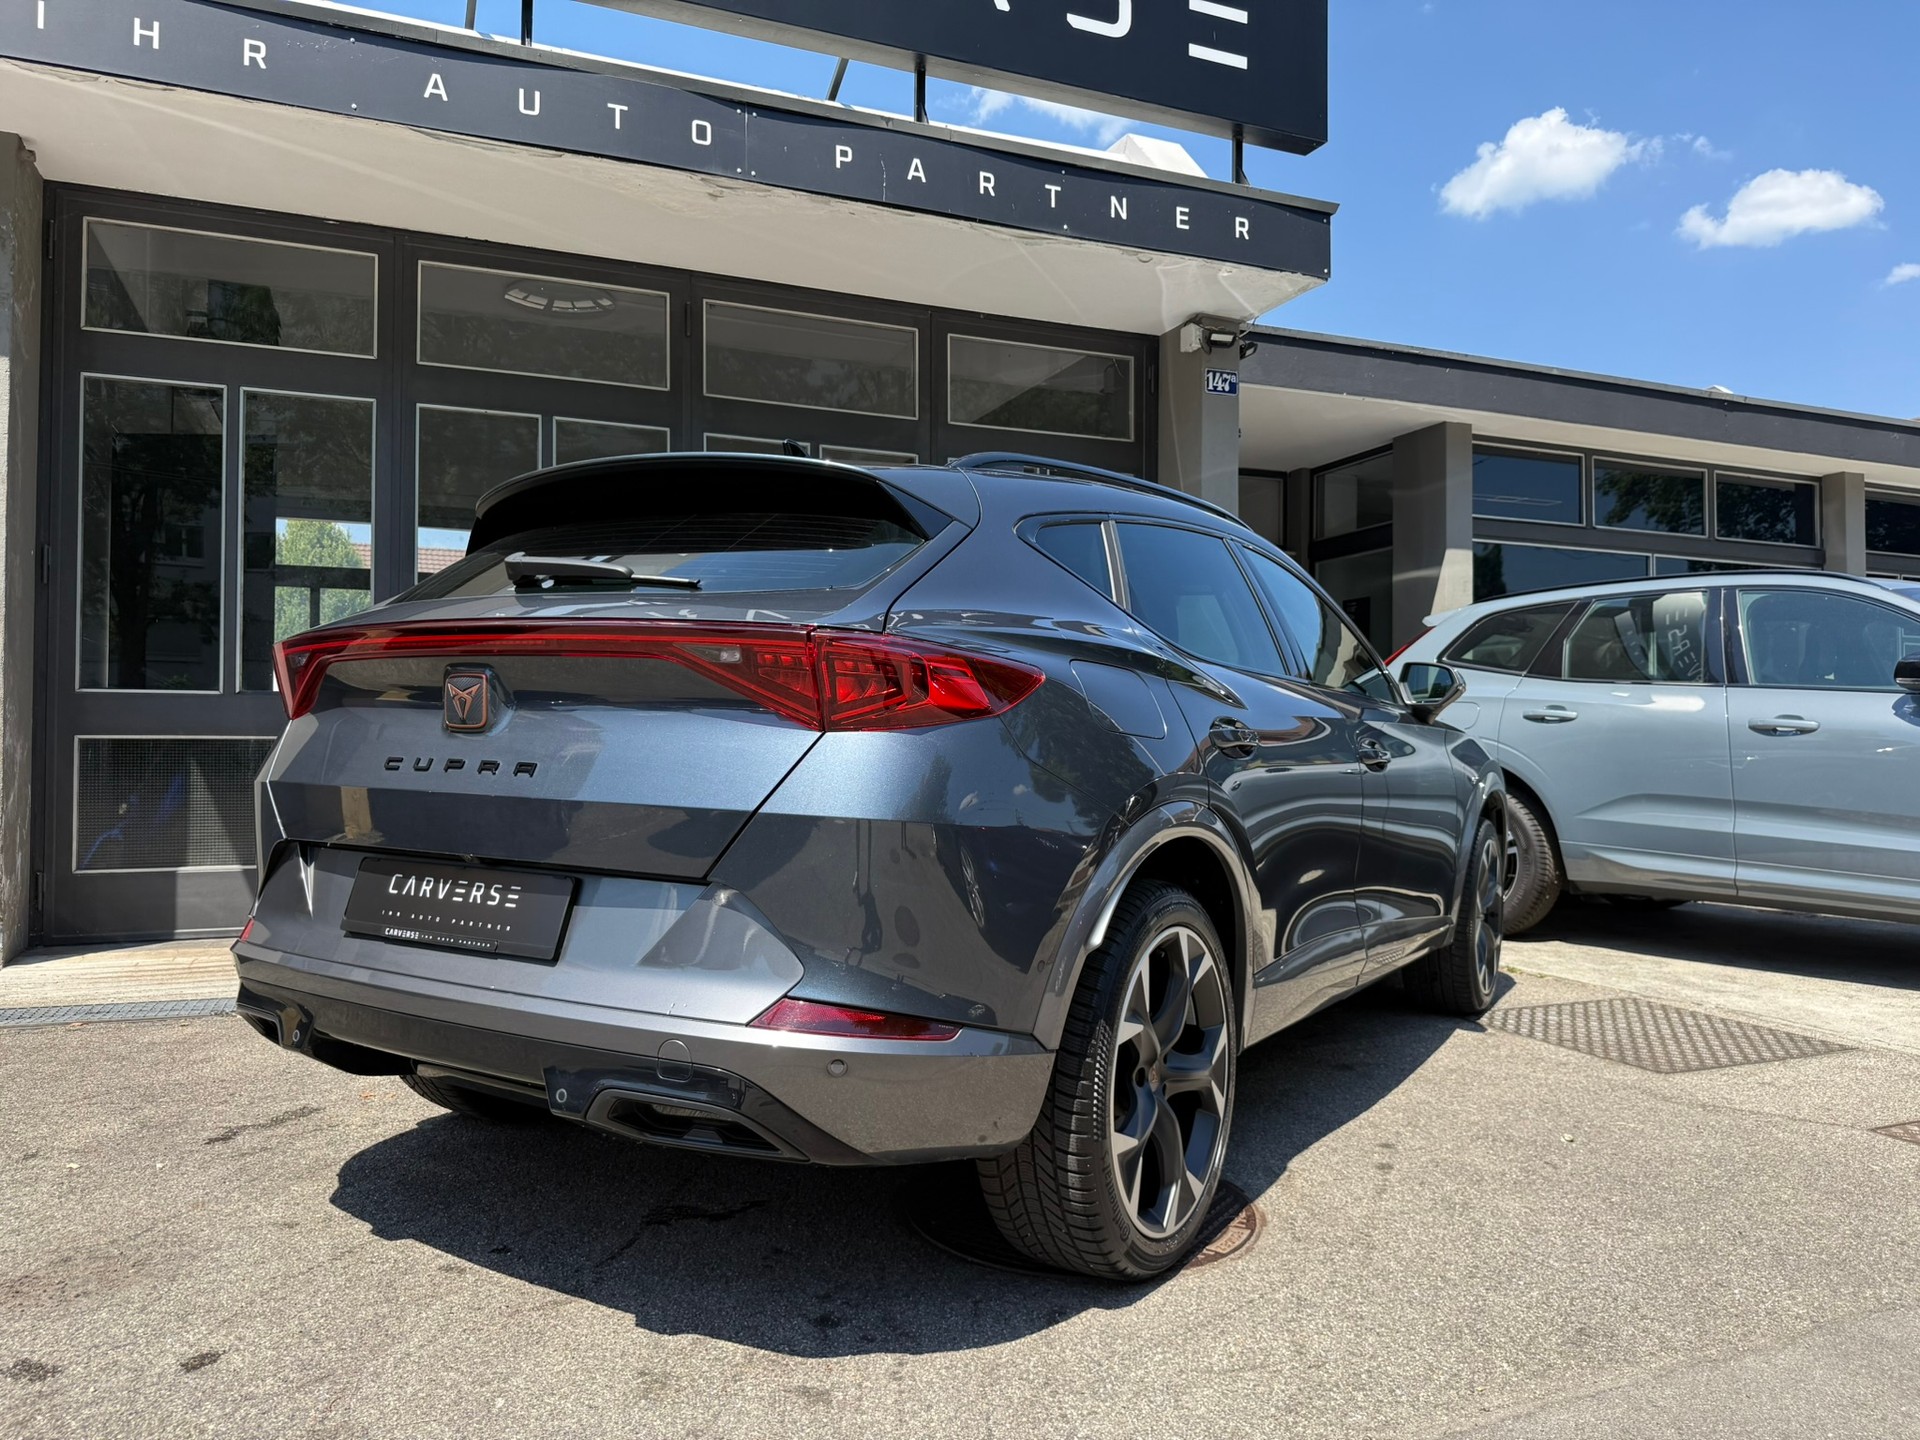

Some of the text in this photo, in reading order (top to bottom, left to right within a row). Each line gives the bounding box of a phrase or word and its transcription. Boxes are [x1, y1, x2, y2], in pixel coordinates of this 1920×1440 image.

[36, 0, 1251, 241] IHR AUTO PARTNER
[383, 756, 539, 779] CUPRA
[387, 873, 523, 908] CARVERSE
[384, 927, 420, 941] CARVERSE
